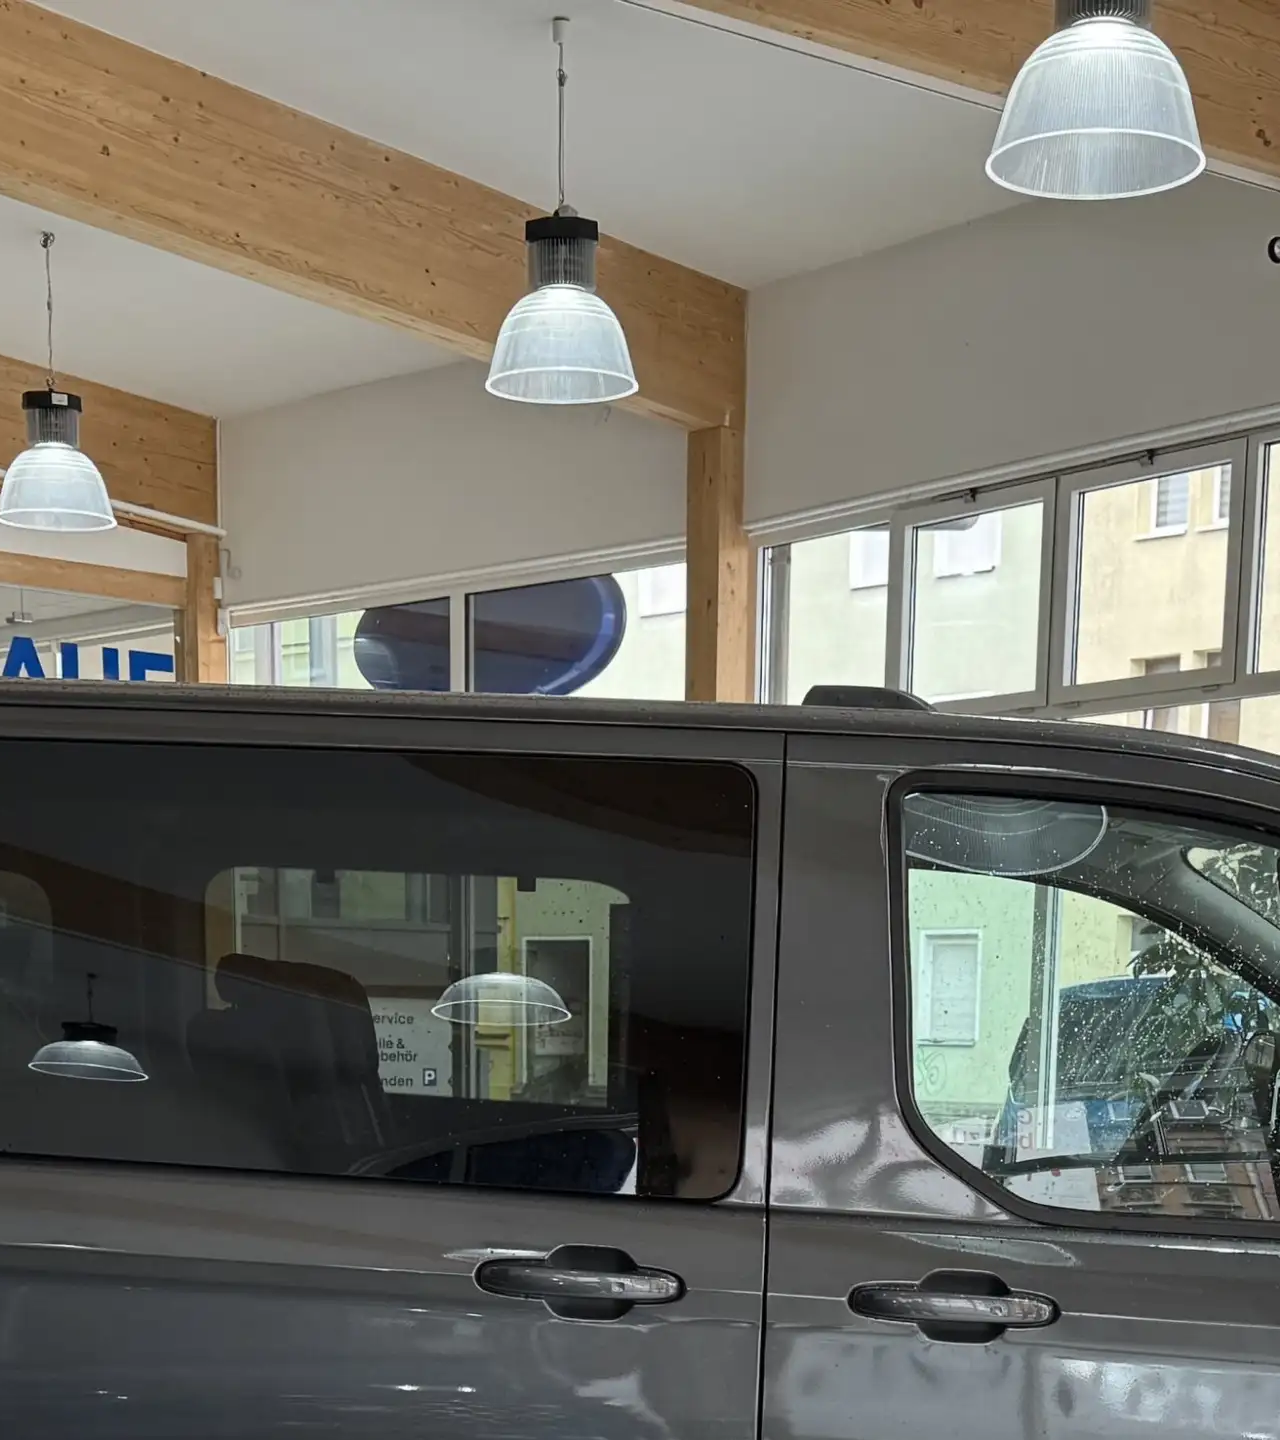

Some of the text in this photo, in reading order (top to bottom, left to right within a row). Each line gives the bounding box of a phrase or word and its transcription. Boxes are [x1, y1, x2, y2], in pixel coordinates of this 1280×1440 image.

[373, 1012, 415, 1025] ervice
[380, 1050, 418, 1062] behör
[382, 1075, 414, 1087] nden
